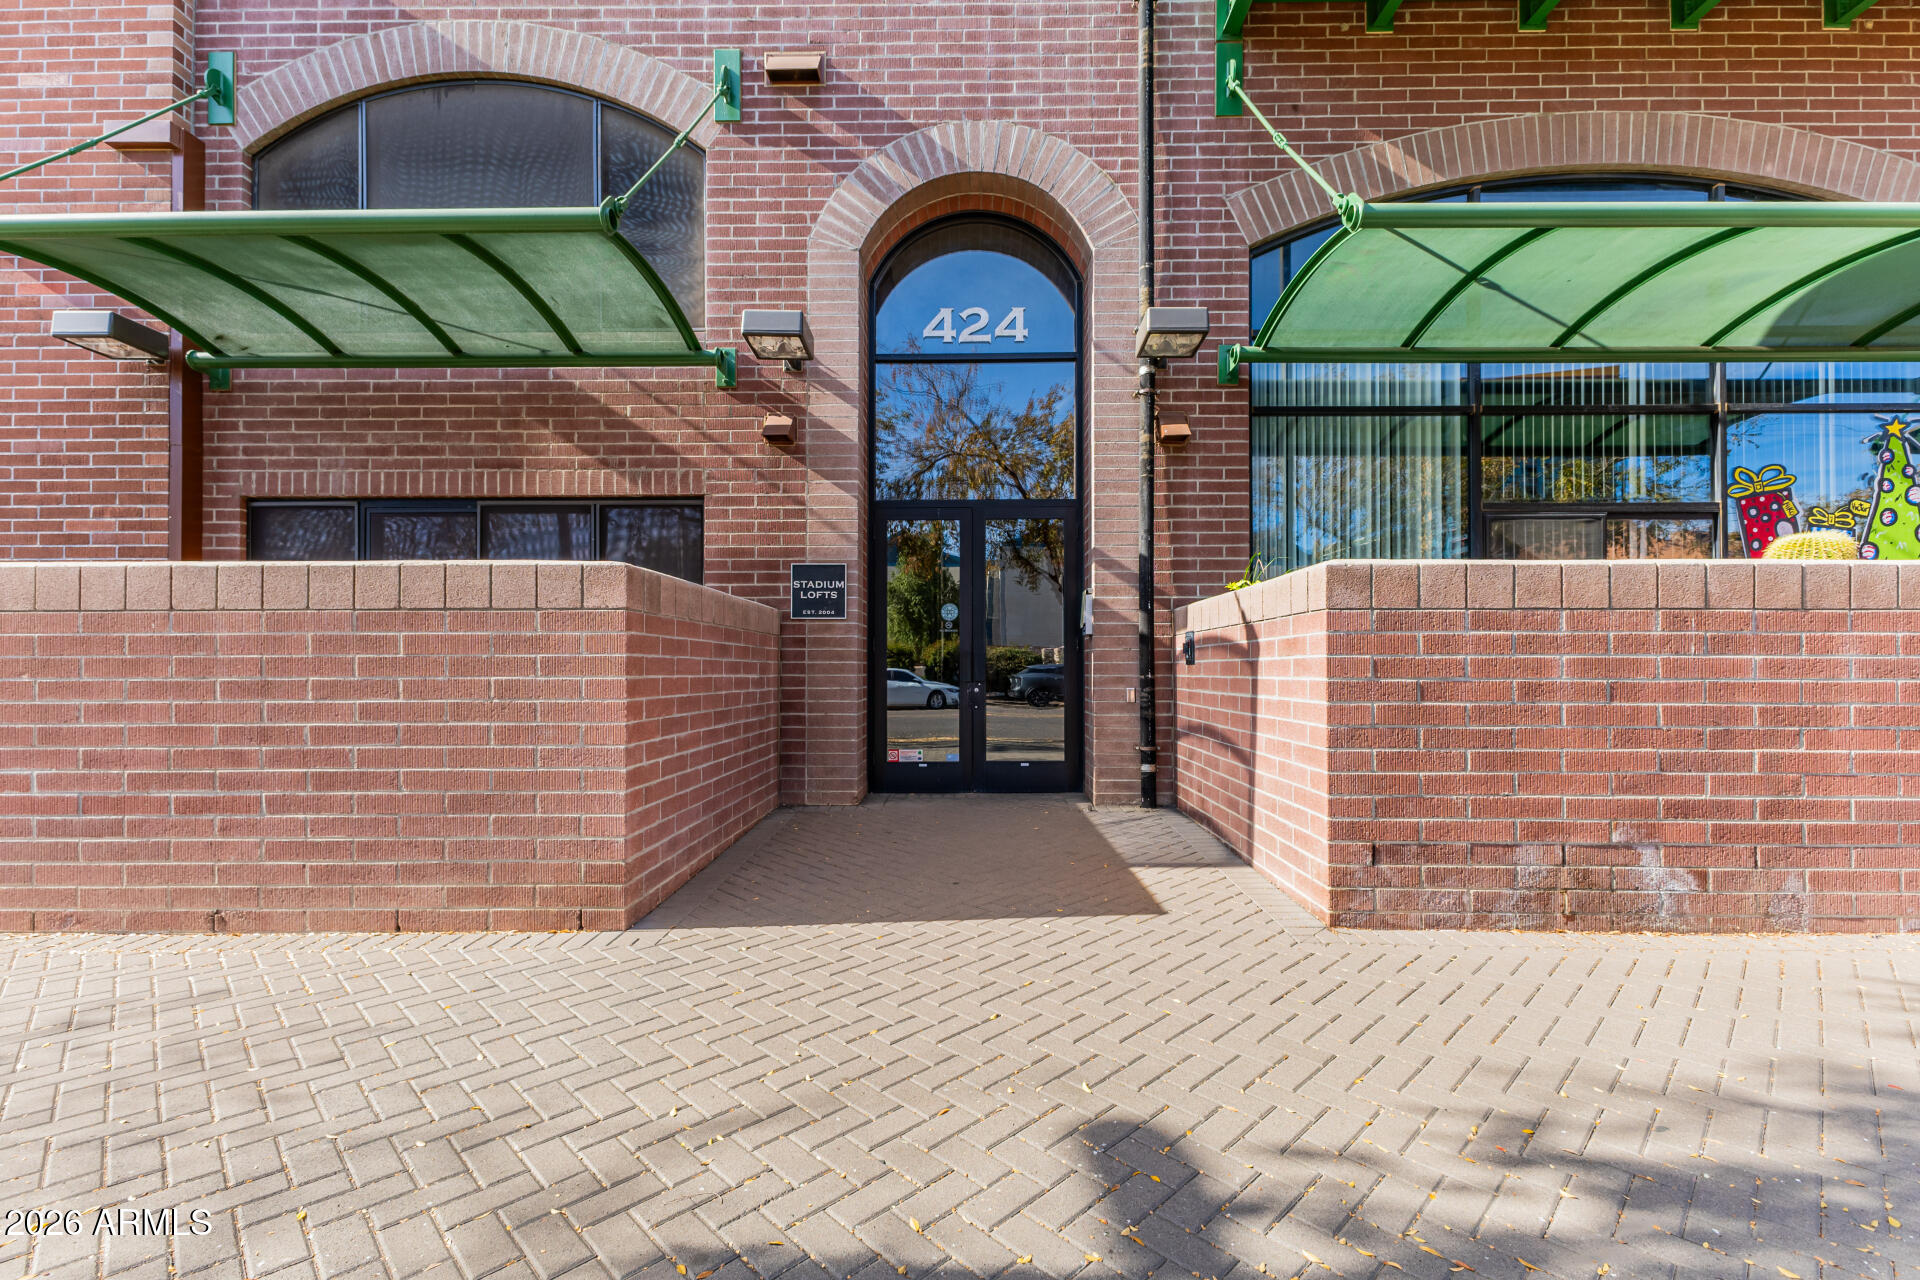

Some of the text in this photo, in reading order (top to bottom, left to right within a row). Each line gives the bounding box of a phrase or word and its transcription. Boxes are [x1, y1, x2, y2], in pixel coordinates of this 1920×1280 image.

[923, 306, 1029, 344] 424
[793, 580, 845, 589] STADIUM
[800, 591, 838, 599] LOFTS
